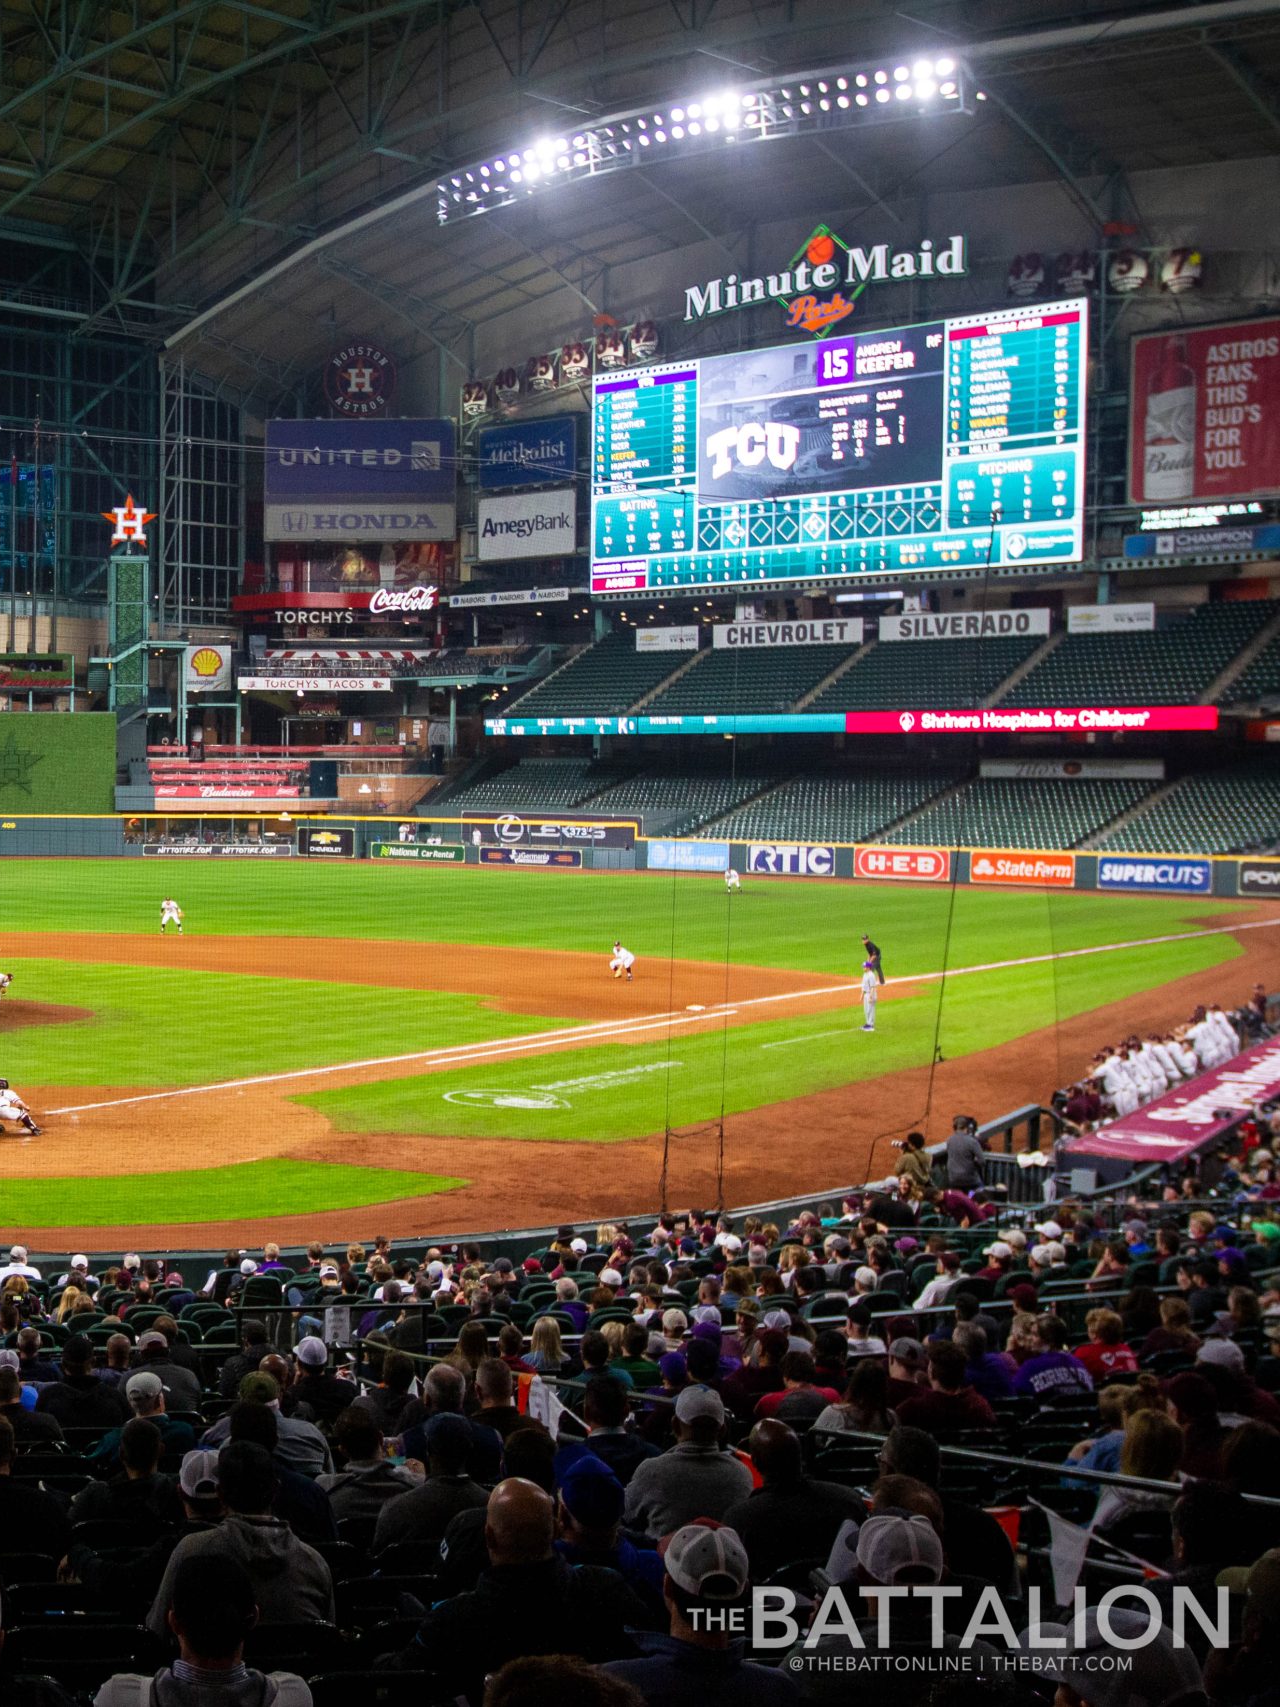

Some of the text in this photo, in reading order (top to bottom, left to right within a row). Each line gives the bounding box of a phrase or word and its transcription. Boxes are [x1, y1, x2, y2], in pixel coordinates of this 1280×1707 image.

[683, 235, 966, 322] Minute Maid
[786, 293, 855, 332] Park
[333, 346, 389, 367] HOUSTON
[856, 334, 943, 358] ANDREW RF
[1206, 337, 1278, 364] ASTROS
[822, 348, 849, 379] 15
[856, 351, 915, 375] KEEFER
[335, 395, 385, 413] ASTROS
[1206, 384, 1248, 406] THIS
[1205, 404, 1262, 427] BUD'S
[1204, 428, 1241, 449] FOR
[279, 449, 401, 466] UNITED
[611, 451, 636, 461] KEEFER
[706, 421, 800, 479] TCU
[1204, 449, 1246, 470] YOU.
[977, 459, 1034, 477] PITCHING
[620, 499, 657, 512] BATTING
[784, 502, 791, 512] 4
[312, 513, 437, 530] HONDA
[482, 512, 570, 538] AmegyBank
[1176, 530, 1253, 545] CHAMPION
[461, 590, 565, 604] NABORS NABORS NABORS
[275, 610, 353, 624] TORCHYS
[899, 614, 1030, 637] SILVERADO
[727, 622, 848, 645] CHEVROLET
[264, 678, 365, 690] TORCHYS TACOS
[618, 718, 627, 734] K
[921, 712, 981, 730] Shriners
[982, 711, 1052, 731] Hospitals
[1054, 710, 1076, 728] for
[199, 786, 255, 798] Budweiser
[1, 822, 16, 830] 409
[569, 827, 588, 836] 373
[157, 845, 277, 854] NITTOTIRE.COM NITTOTIRE.COM
[389, 846, 455, 859] National Car Rental
[749, 846, 832, 874] RTIC
[1101, 863, 1204, 884] SUPERCUTS
